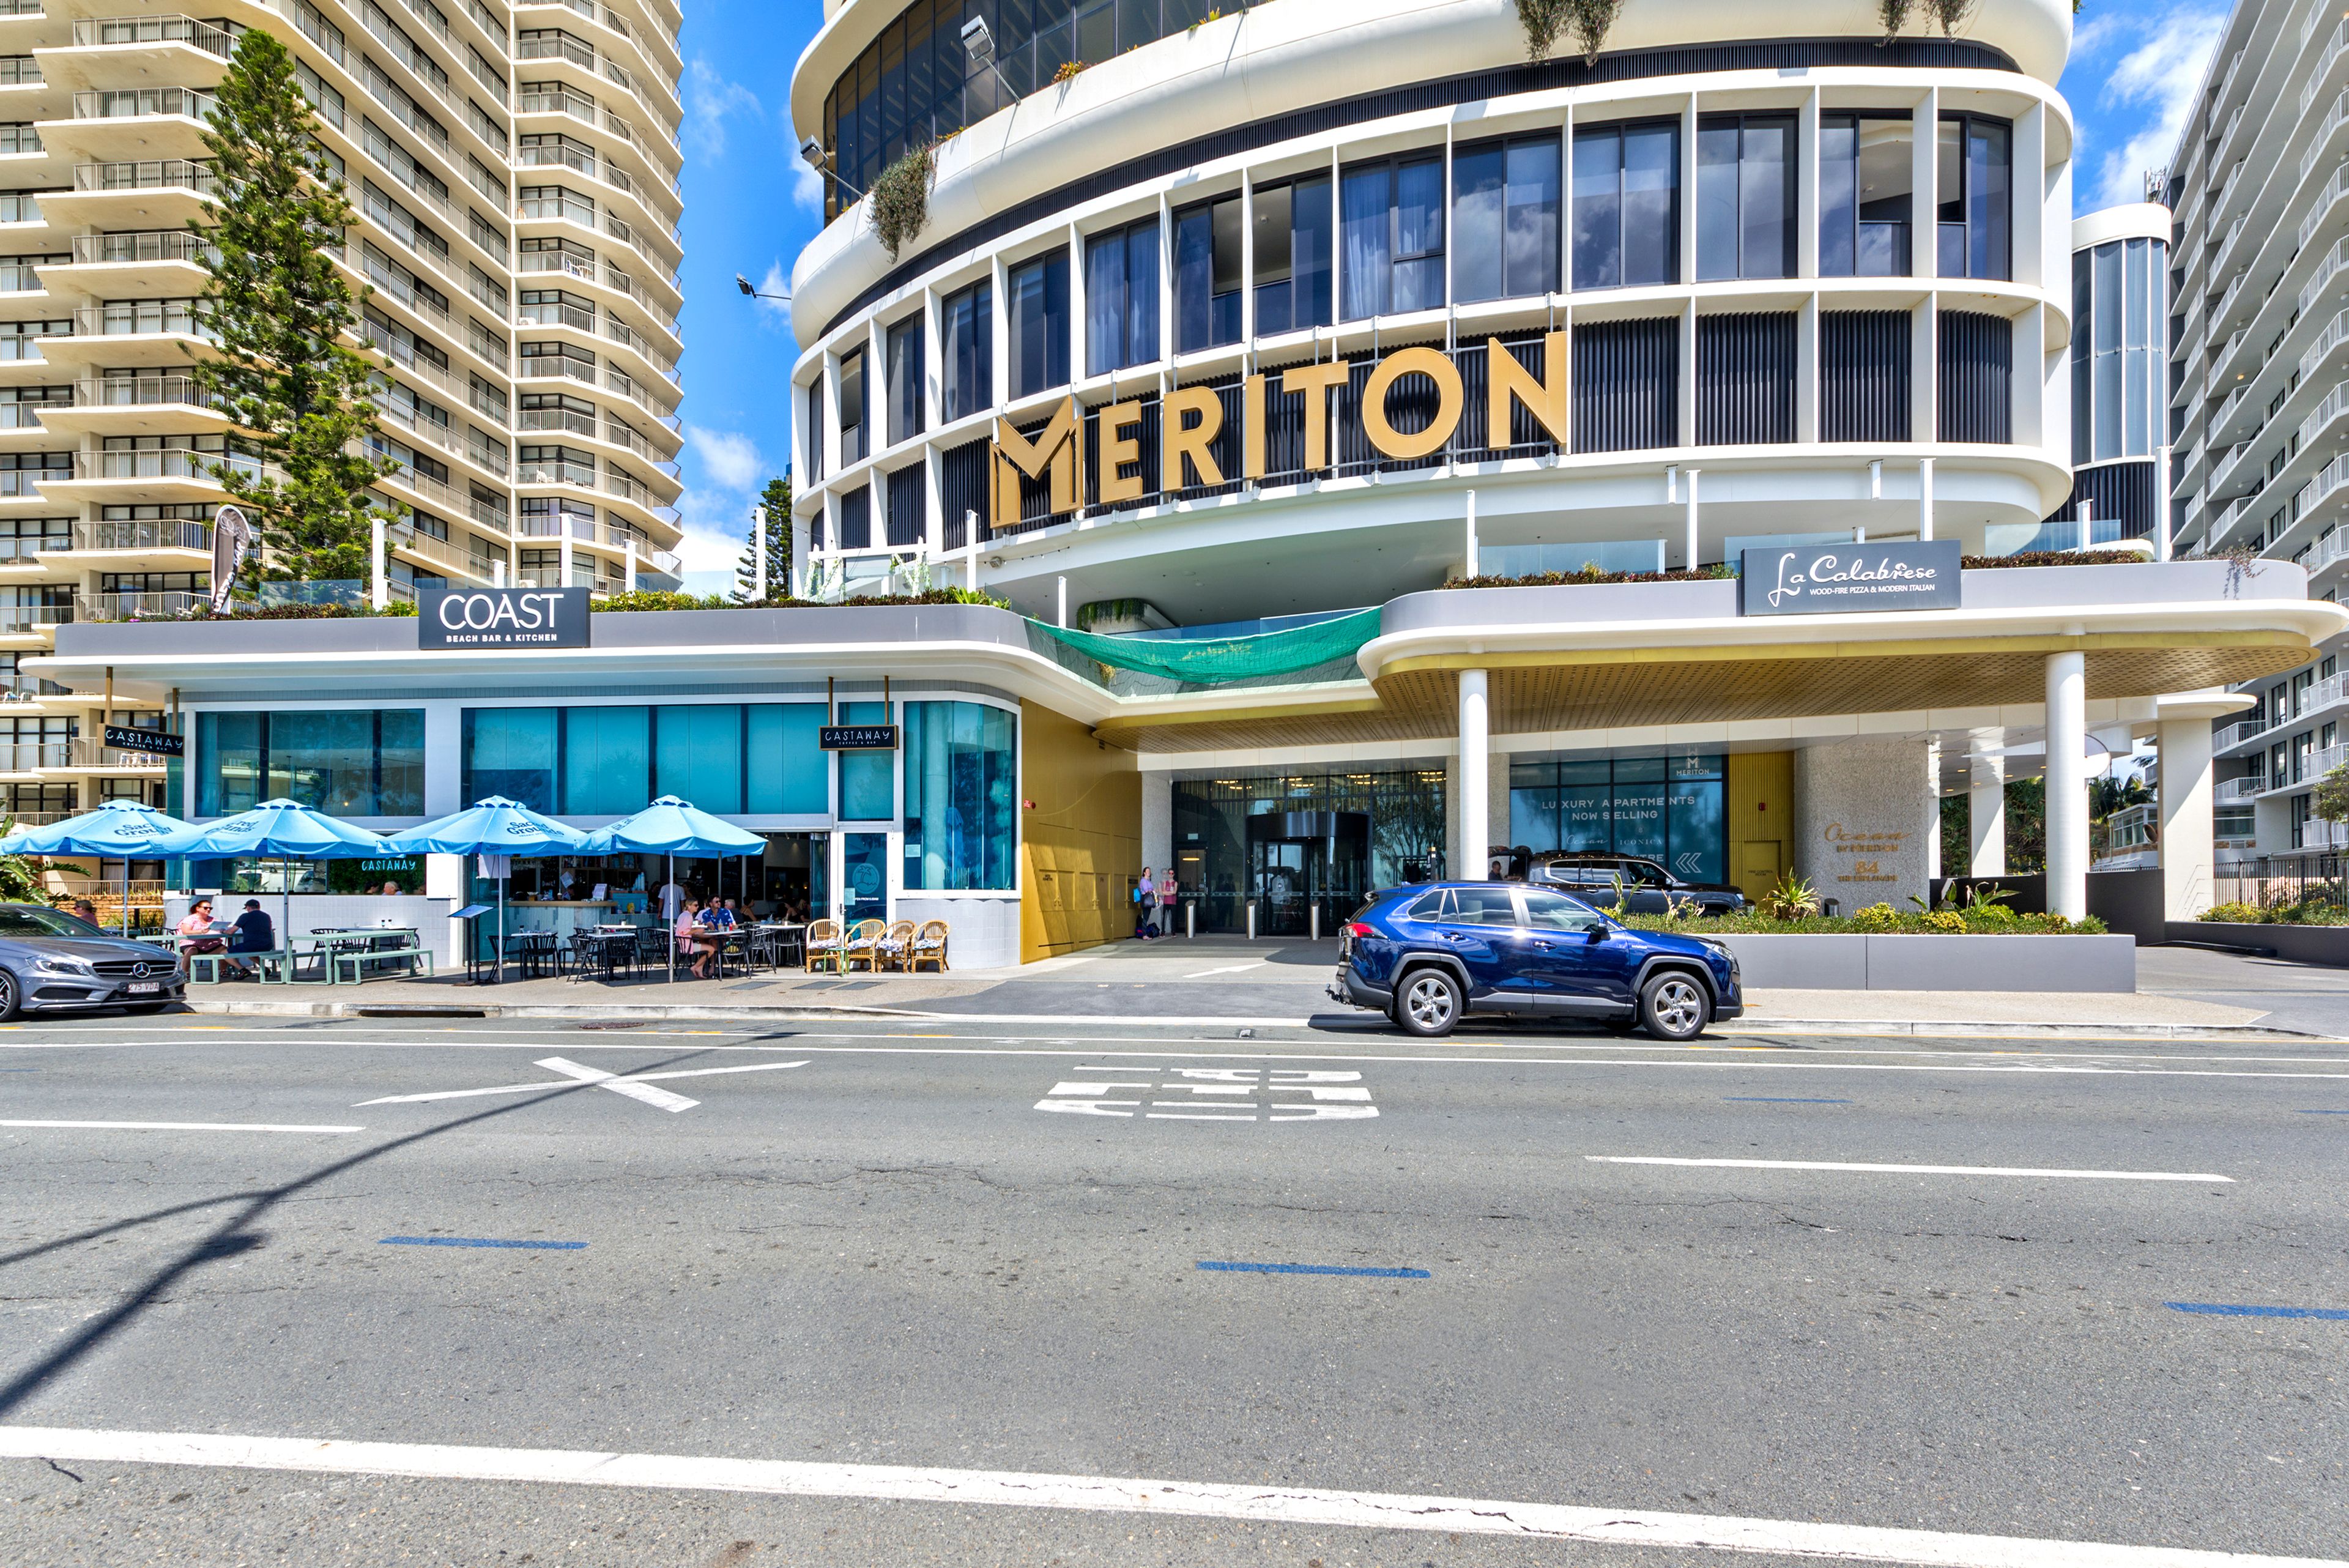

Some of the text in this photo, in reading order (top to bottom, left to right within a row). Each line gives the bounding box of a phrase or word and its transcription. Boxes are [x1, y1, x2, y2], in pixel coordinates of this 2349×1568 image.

[990, 331, 1567, 529] MERITON
[1768, 552, 1937, 608] La Calabrese
[439, 593, 564, 630] COAST
[106, 730, 183, 748] CASTAWAY
[825, 730, 889, 741] CASTAWAY
[1542, 797, 1695, 809] LUXURY APARTMENTS
[1603, 811, 1658, 820] SELLING
[1825, 822, 1913, 842] Ocean
[1567, 834, 1608, 844] Ocean
[1851, 844, 1899, 852] MERITON
[362, 860, 416, 871] CASTAWAY
[1856, 861, 1880, 874] 84
[1033, 1066, 1379, 1121] PED
